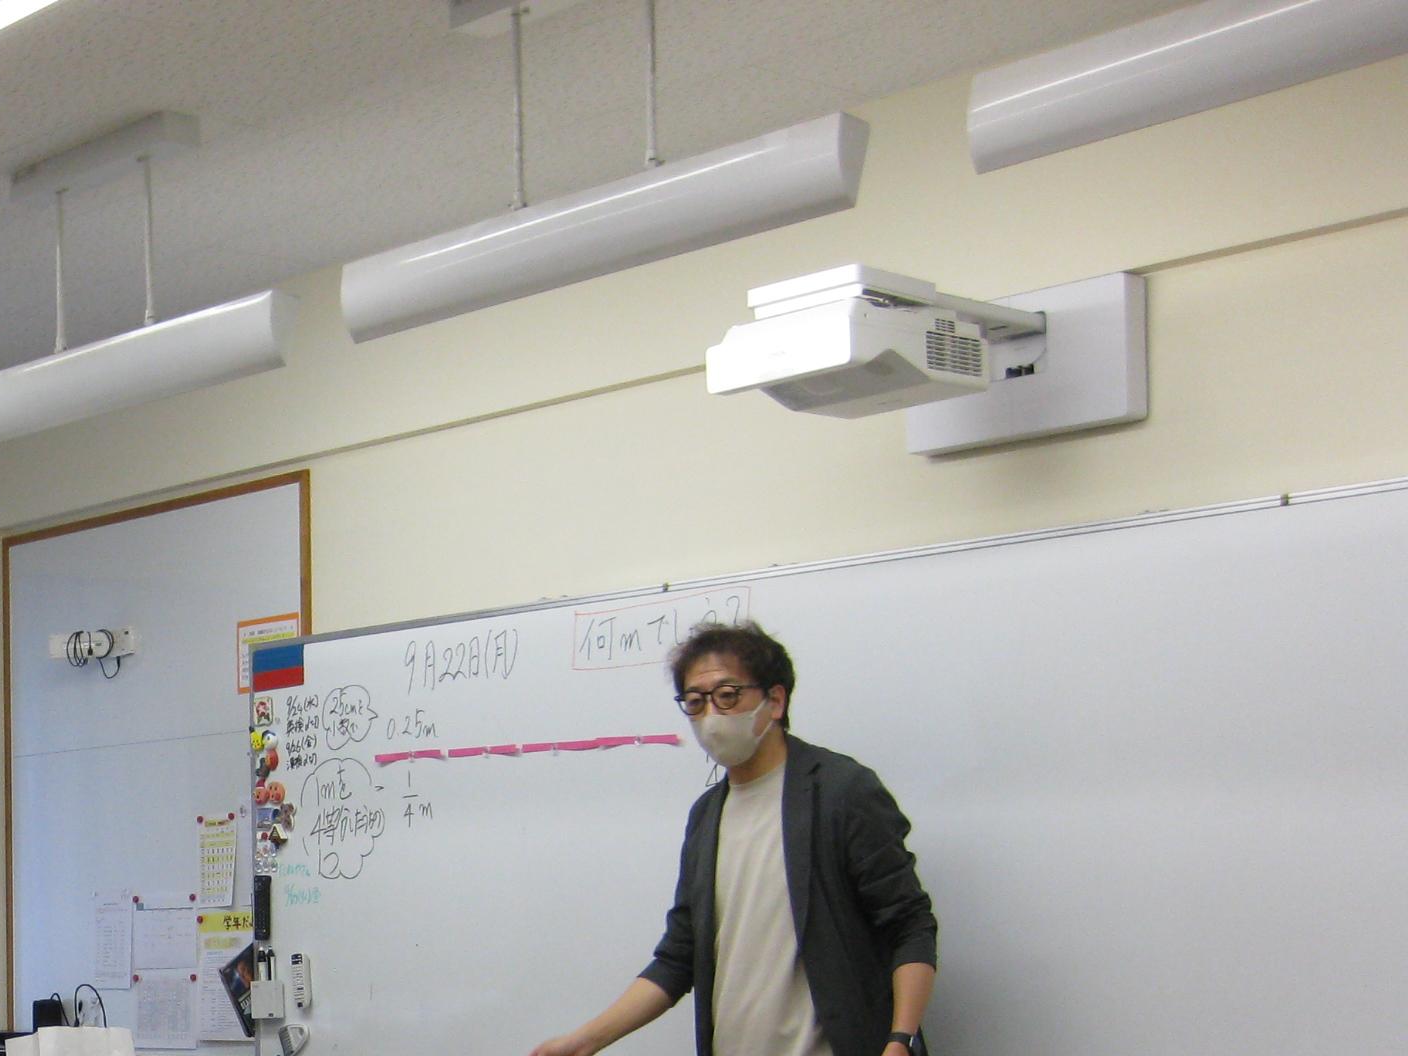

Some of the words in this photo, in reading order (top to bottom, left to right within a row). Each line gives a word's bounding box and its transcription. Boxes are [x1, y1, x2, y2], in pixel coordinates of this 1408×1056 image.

[404, 628, 518, 694] 9月22日(月)
[387, 708, 439, 740] 0.25m
[223, 914, 253, 930] 学年だ
